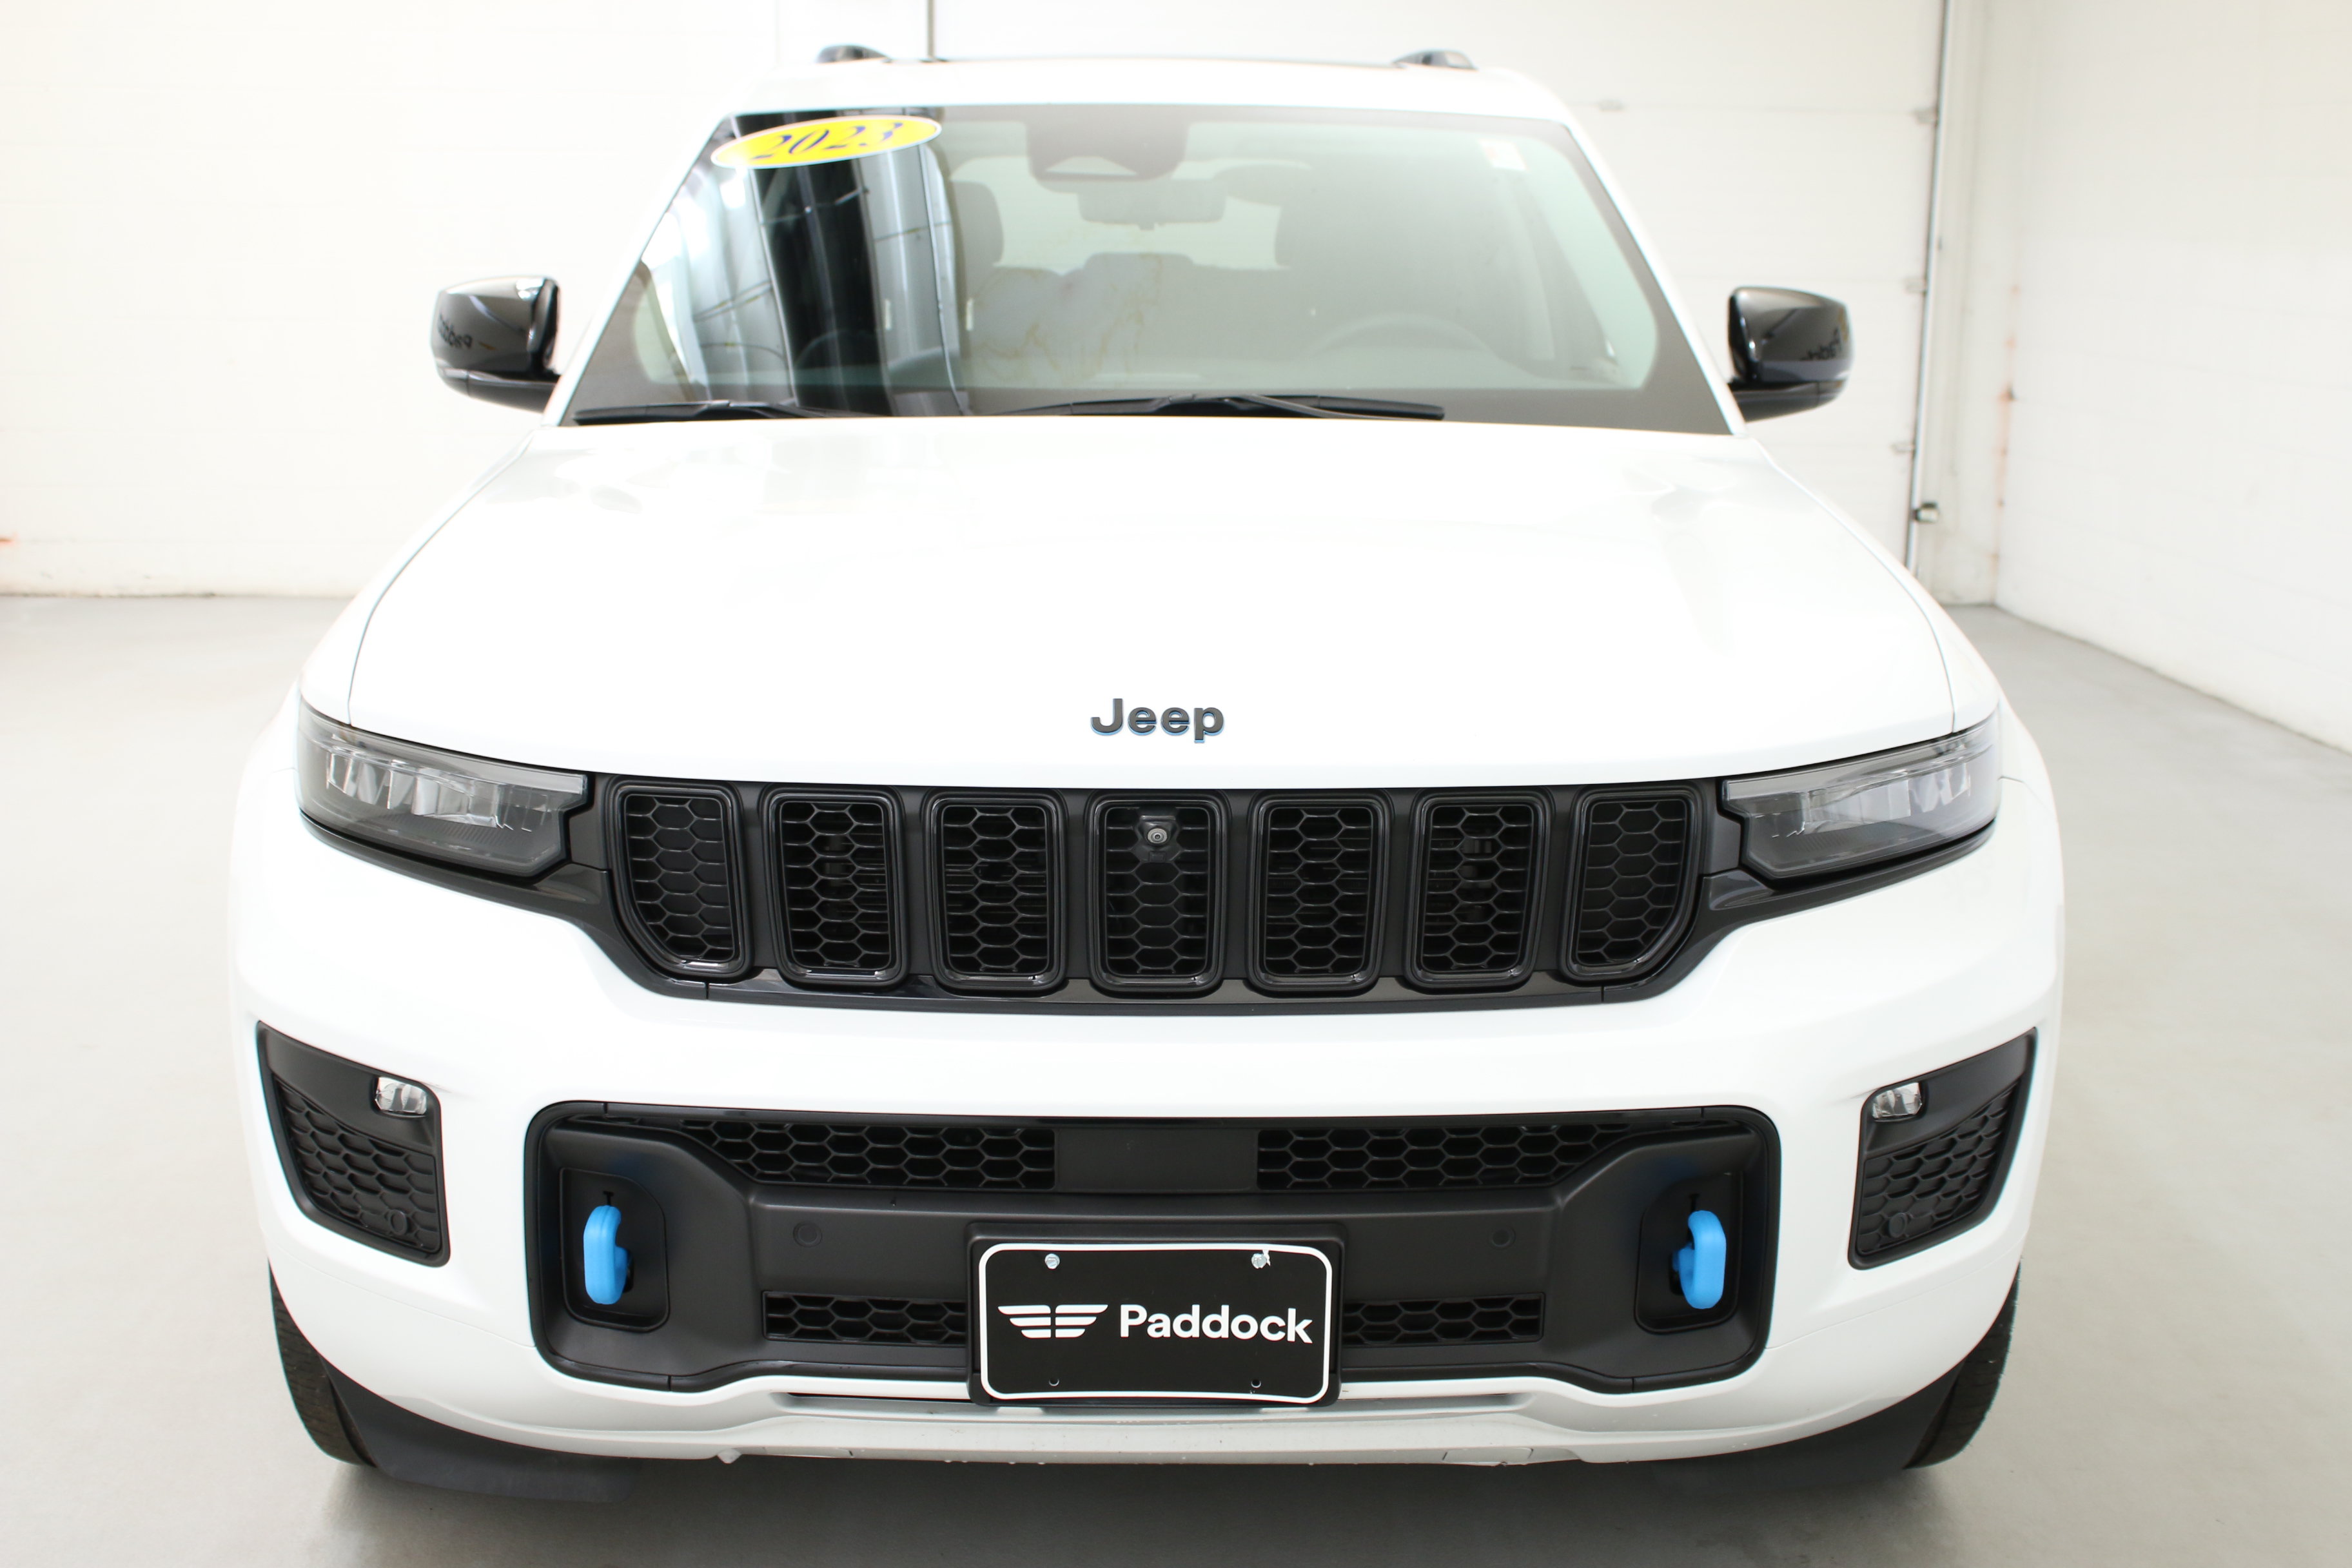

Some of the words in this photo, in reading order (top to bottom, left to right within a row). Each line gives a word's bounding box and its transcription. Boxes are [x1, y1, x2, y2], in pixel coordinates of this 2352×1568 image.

[749, 121, 903, 160] 2023
[1090, 698, 1224, 743] Jeep
[1120, 1304, 1313, 1344] Paddock
